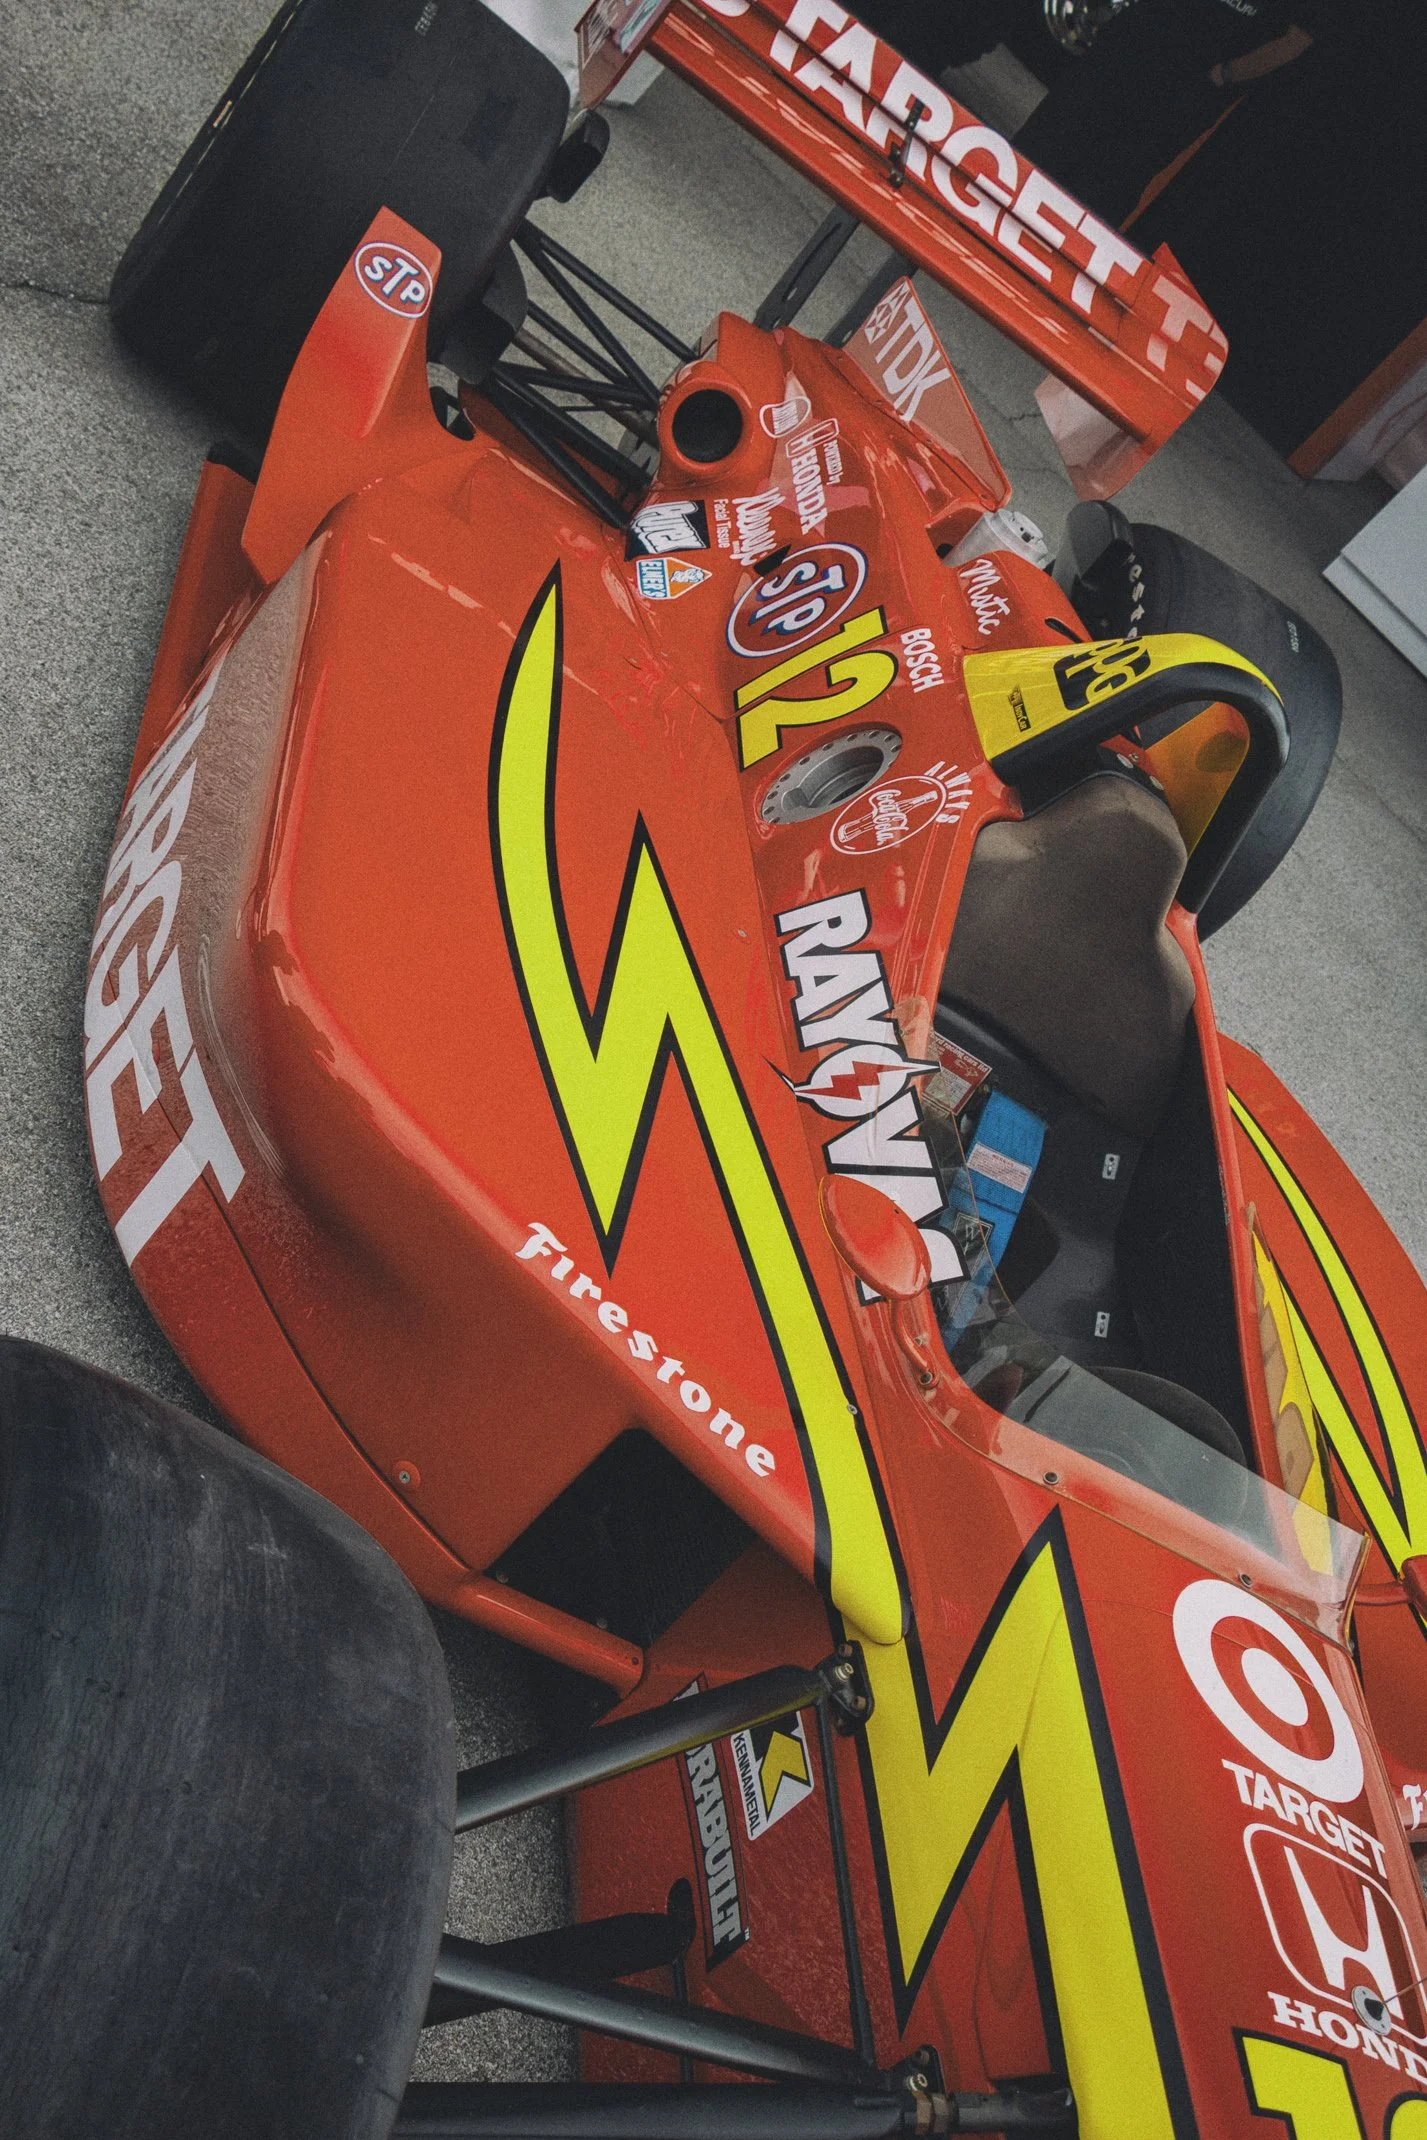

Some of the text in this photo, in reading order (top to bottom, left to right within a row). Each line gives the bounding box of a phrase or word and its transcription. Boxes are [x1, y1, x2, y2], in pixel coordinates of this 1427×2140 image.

[769, 0, 1142, 314] TARGET
[364, 255, 426, 304] STP
[875, 303, 951, 421] TDK
[714, 499, 731, 549] Facial Tissue
[790, 456, 828, 534] HONDA
[640, 558, 668, 598] ELMER'S
[750, 560, 847, 637] STP
[734, 605, 898, 772] 12
[901, 627, 944, 693] BOSCH
[515, 1222, 776, 1477] Firestone
[733, 1733, 761, 1837] KENNAMETAL
[1222, 1759, 1388, 1879] TARGET
